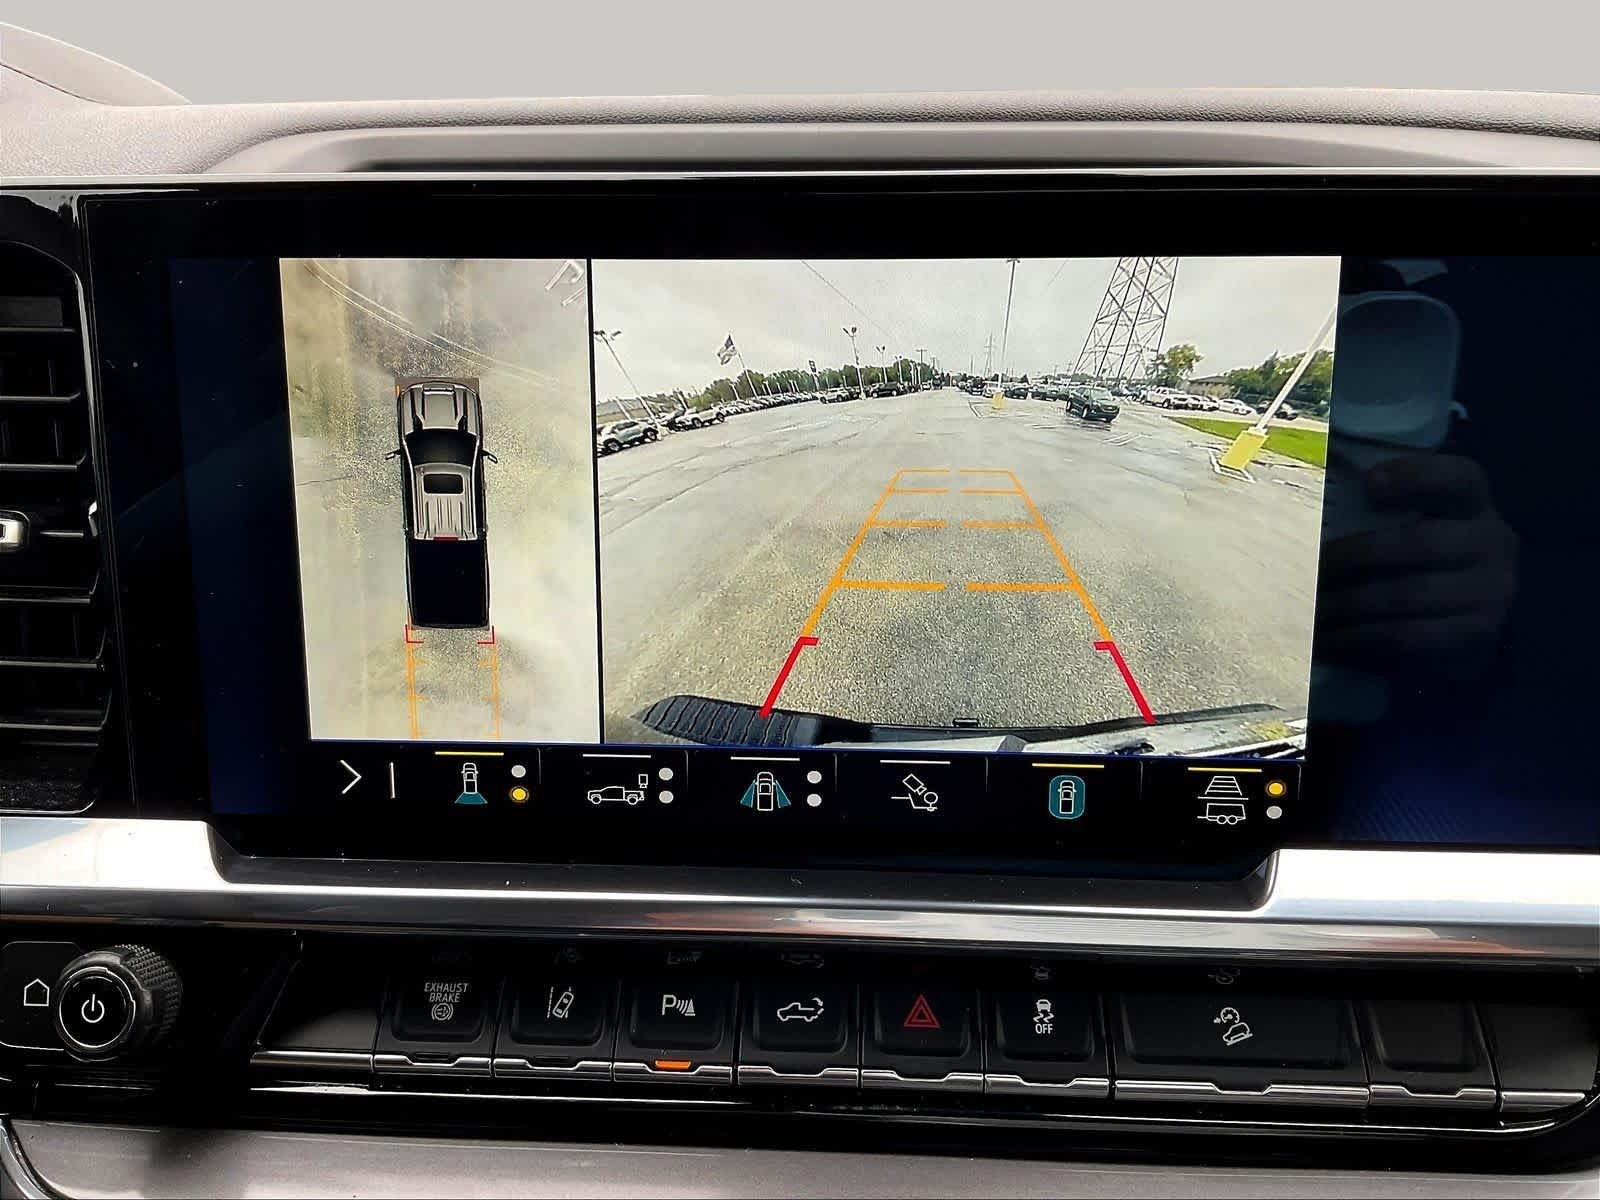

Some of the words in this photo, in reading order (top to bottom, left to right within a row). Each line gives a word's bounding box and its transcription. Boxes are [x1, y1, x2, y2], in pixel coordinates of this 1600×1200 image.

[424, 982, 468, 992] EXHAUST
[429, 993, 460, 1002] BRAKE
[1035, 1023, 1053, 1034] OFF
